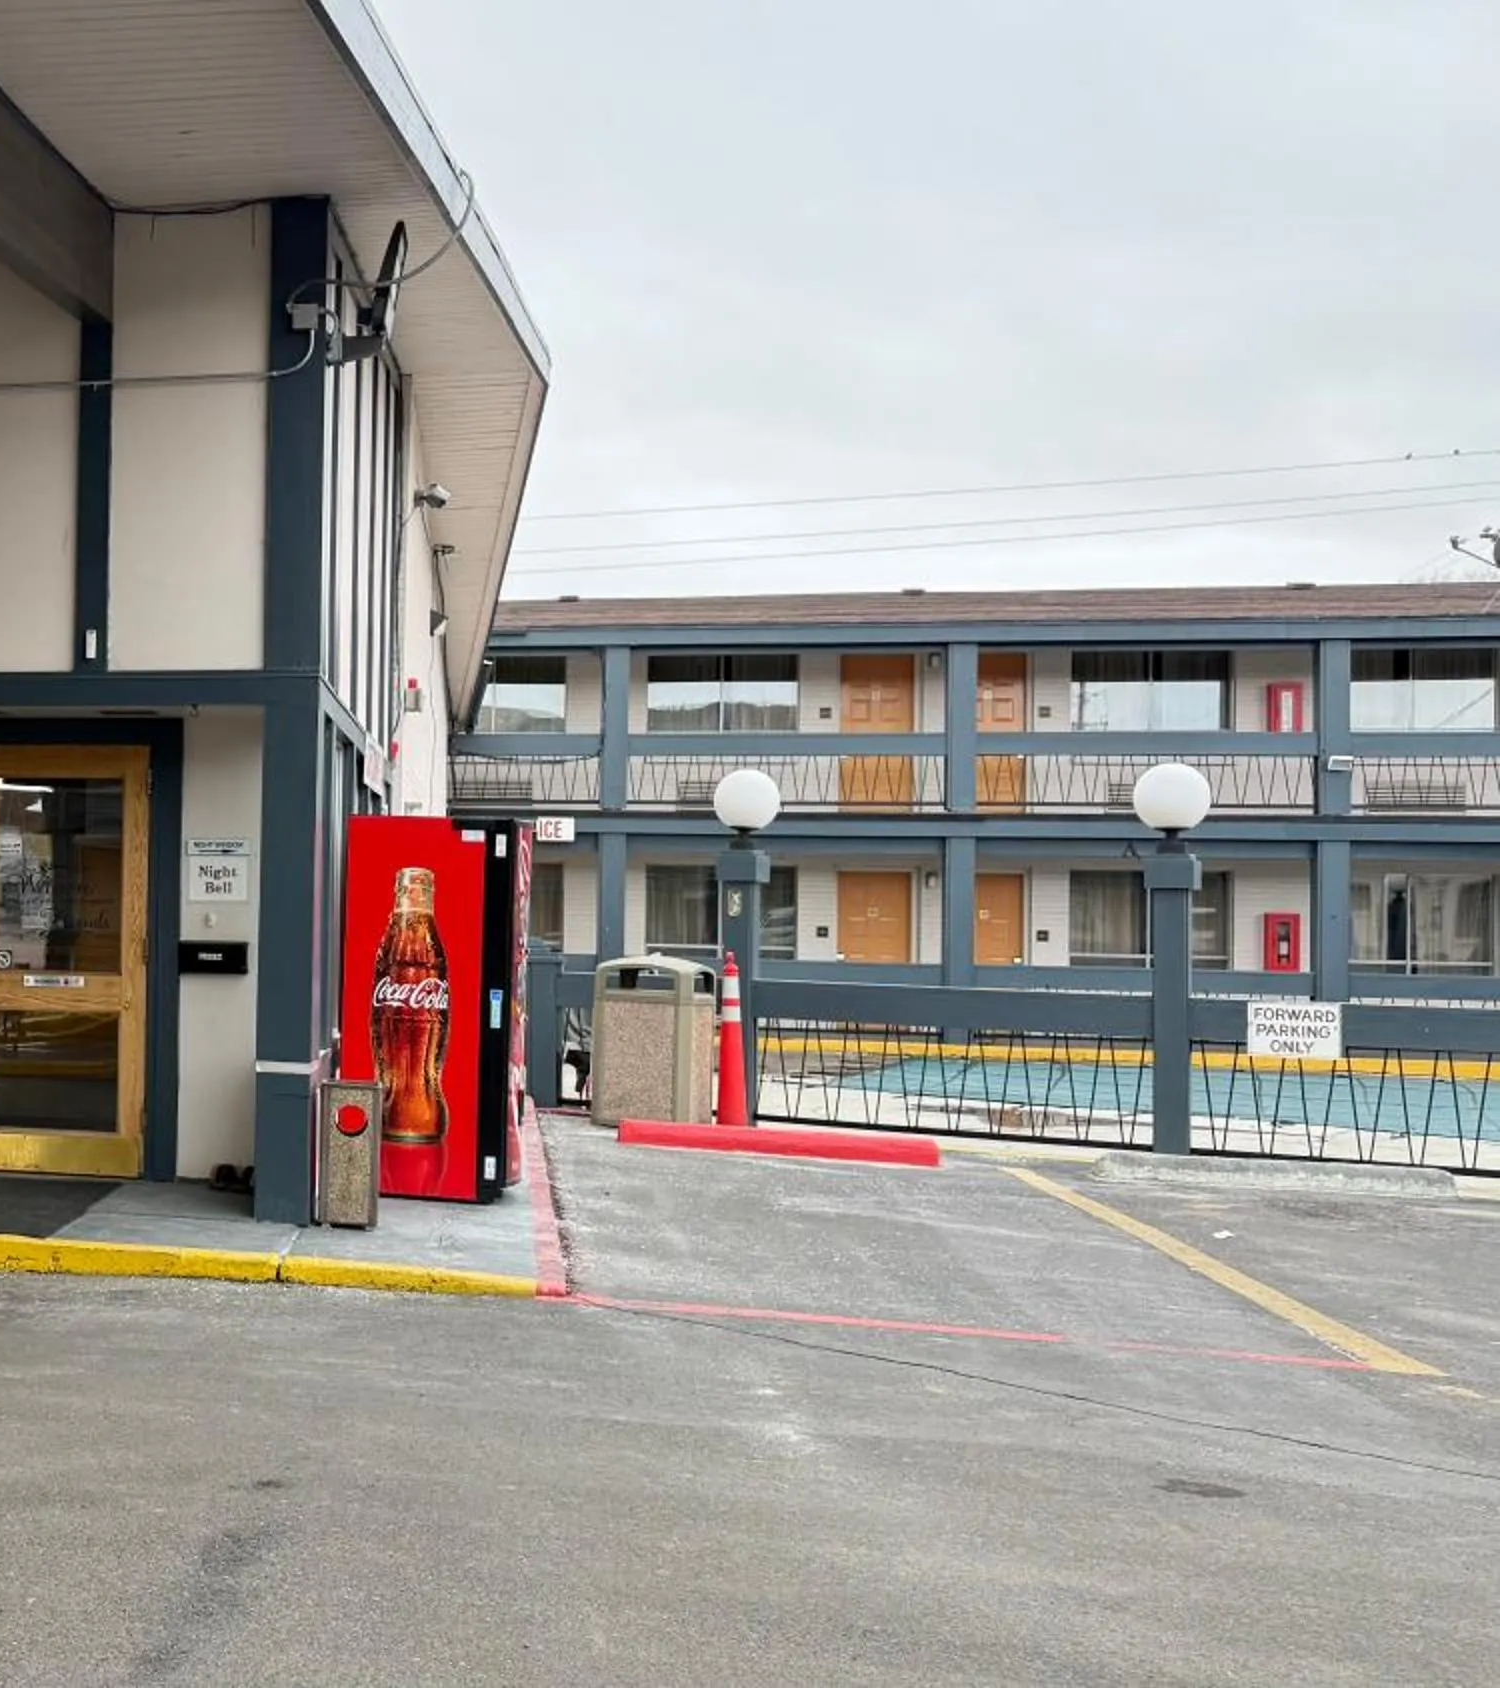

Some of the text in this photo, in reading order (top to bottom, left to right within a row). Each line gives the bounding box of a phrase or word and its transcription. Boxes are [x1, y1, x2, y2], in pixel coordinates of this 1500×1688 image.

[540, 820, 563, 838] ICE
[198, 865, 238, 880] Night
[205, 881, 232, 894] Bell
[373, 976, 448, 1009] Coca-Cola
[1254, 1007, 1337, 1023] FORWARD
[1255, 1023, 1331, 1039] PARKING
[1269, 1039, 1315, 1054] ONLY
